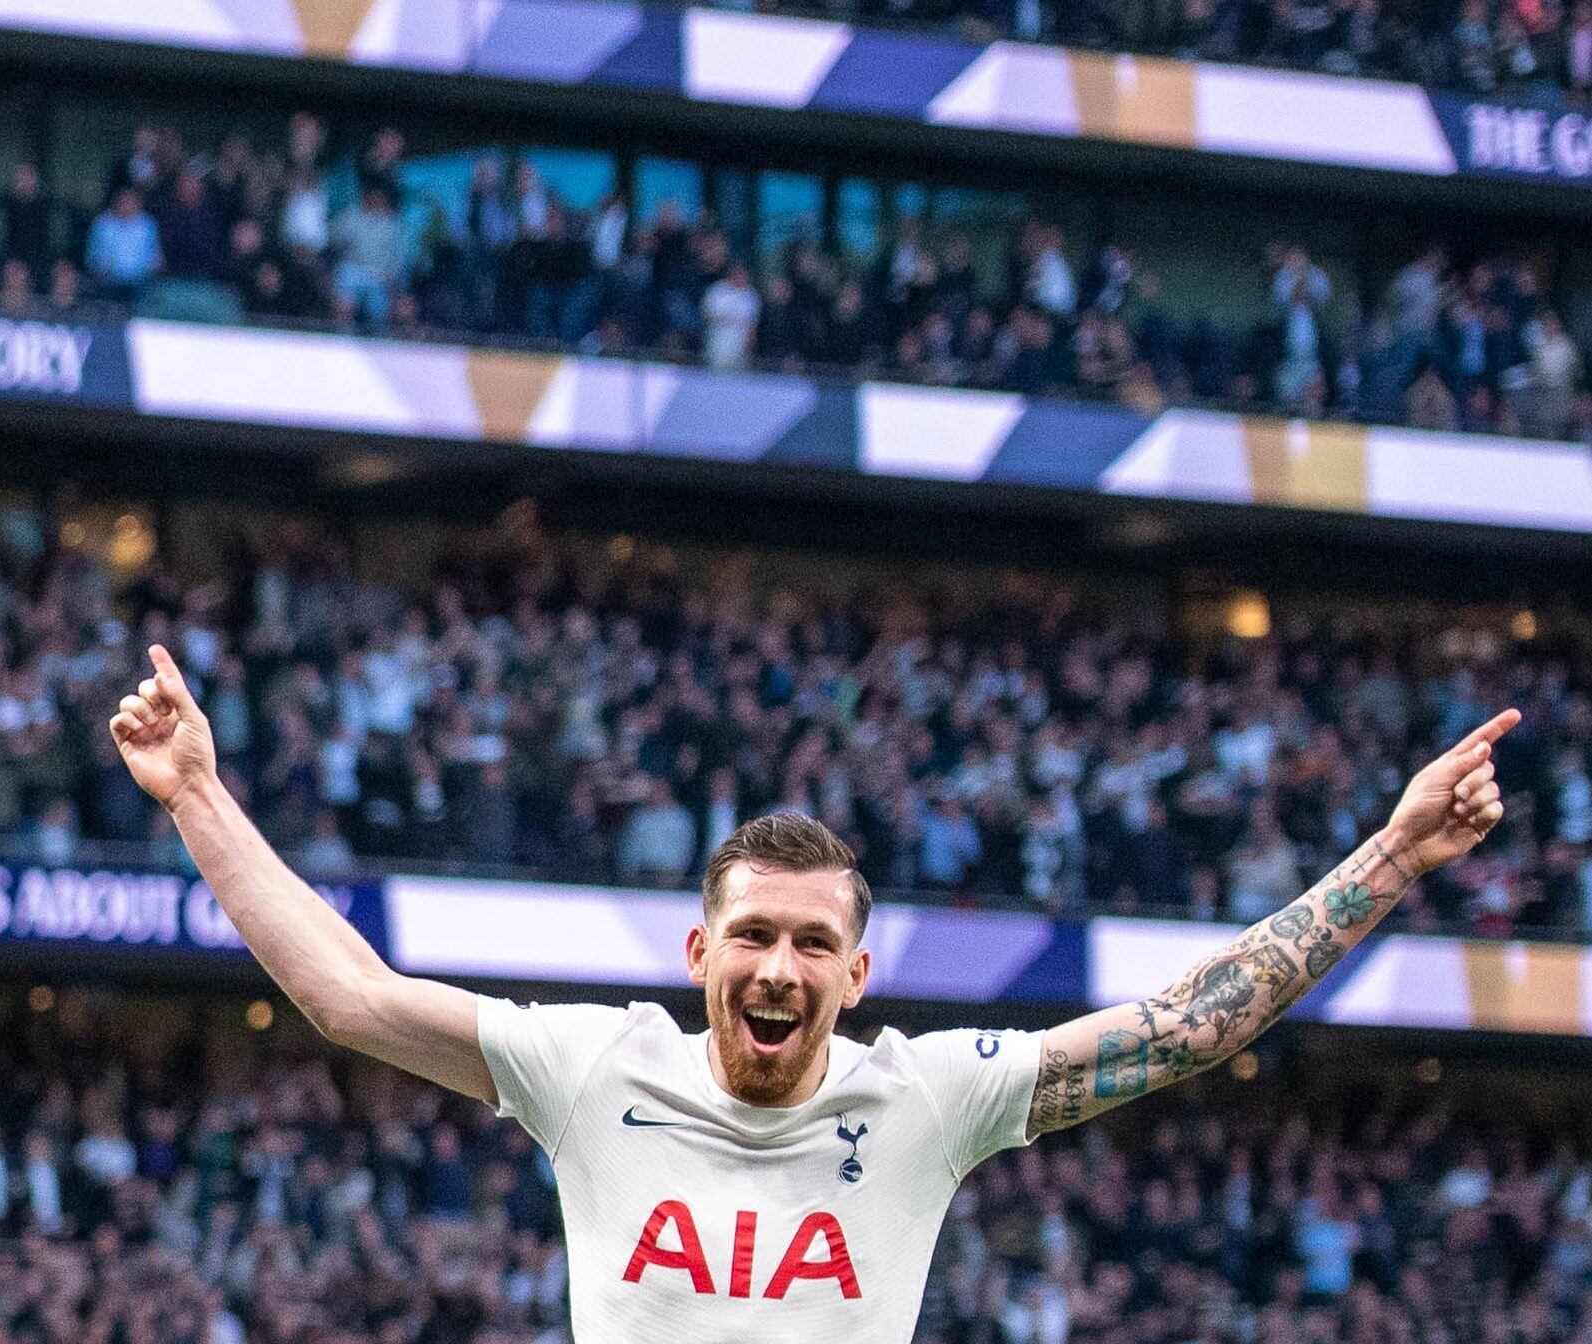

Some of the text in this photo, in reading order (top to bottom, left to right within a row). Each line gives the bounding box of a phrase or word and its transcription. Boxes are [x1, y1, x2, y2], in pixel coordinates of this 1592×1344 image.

[1467, 103, 1551, 173] THE
[15, 867, 187, 944] ABOUT
[623, 1200, 861, 1299] AIA
